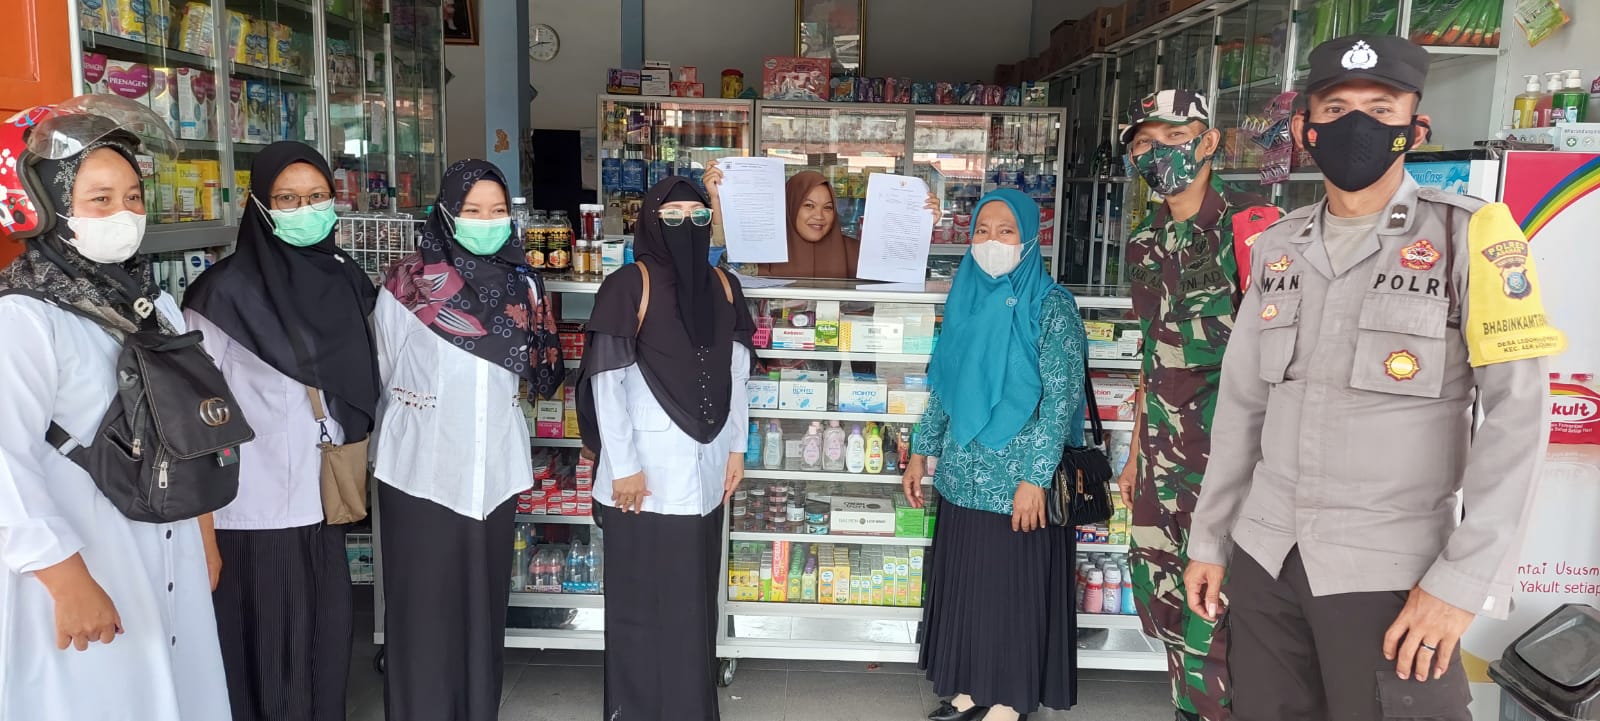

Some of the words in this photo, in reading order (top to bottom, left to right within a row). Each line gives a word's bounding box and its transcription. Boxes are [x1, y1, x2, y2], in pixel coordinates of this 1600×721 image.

[109, 77, 148, 87] PRENAGEN
[1487, 241, 1525, 256] POLRES
[1203, 270, 1221, 286] AD
[1263, 274, 1301, 293] WAN
[1551, 402, 1590, 416] kult
[1517, 562, 1548, 575] ntai
[1519, 580, 1561, 593] Yakult
